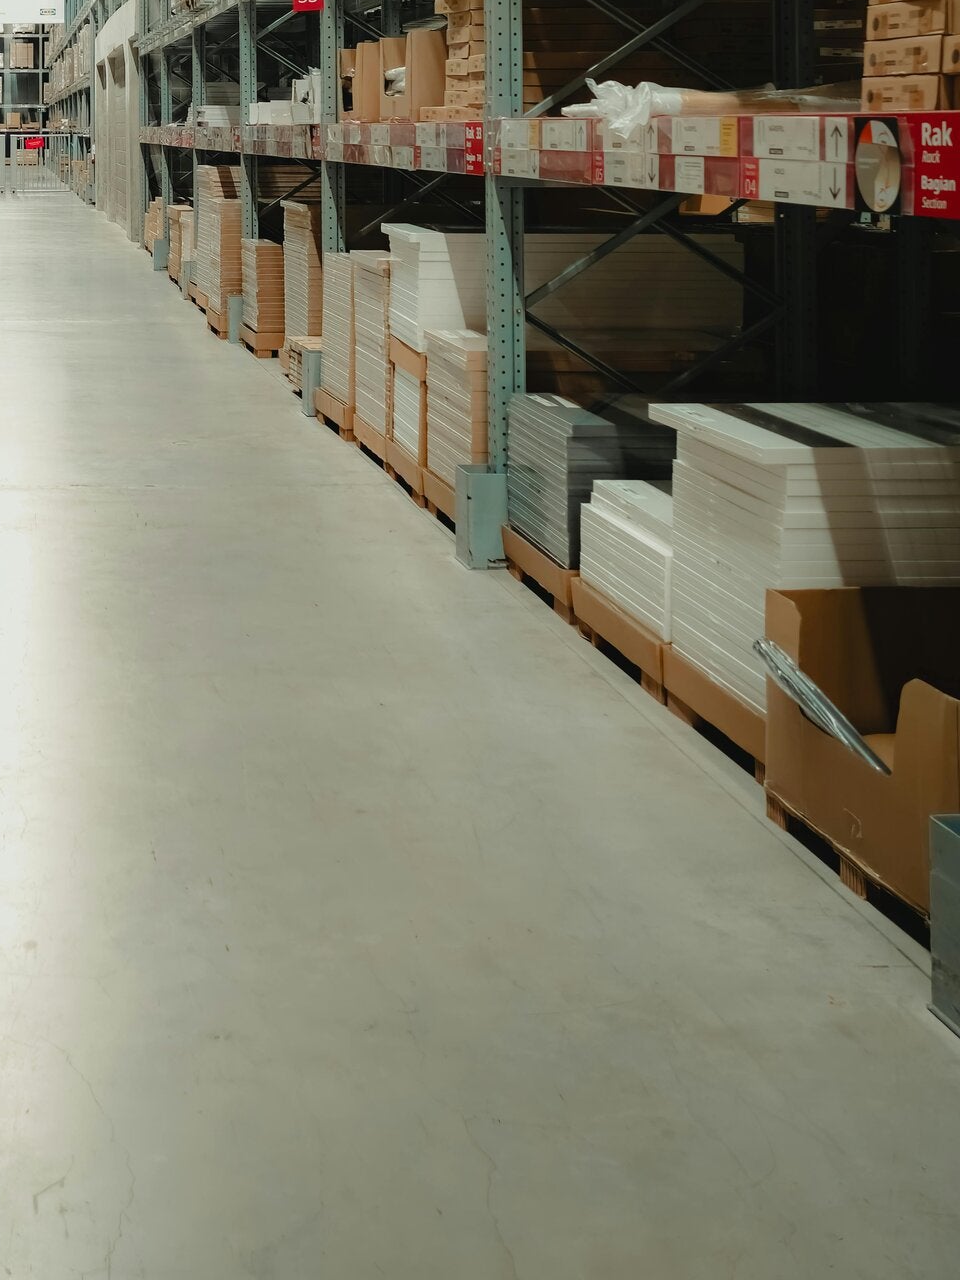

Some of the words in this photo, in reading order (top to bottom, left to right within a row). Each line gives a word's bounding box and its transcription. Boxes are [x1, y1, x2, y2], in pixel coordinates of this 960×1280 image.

[921, 120, 953, 146] Rak
[922, 150, 940, 163] Rack
[744, 178, 756, 194] 04
[920, 175, 956, 195] Bagian
[921, 196, 947, 209] Section
